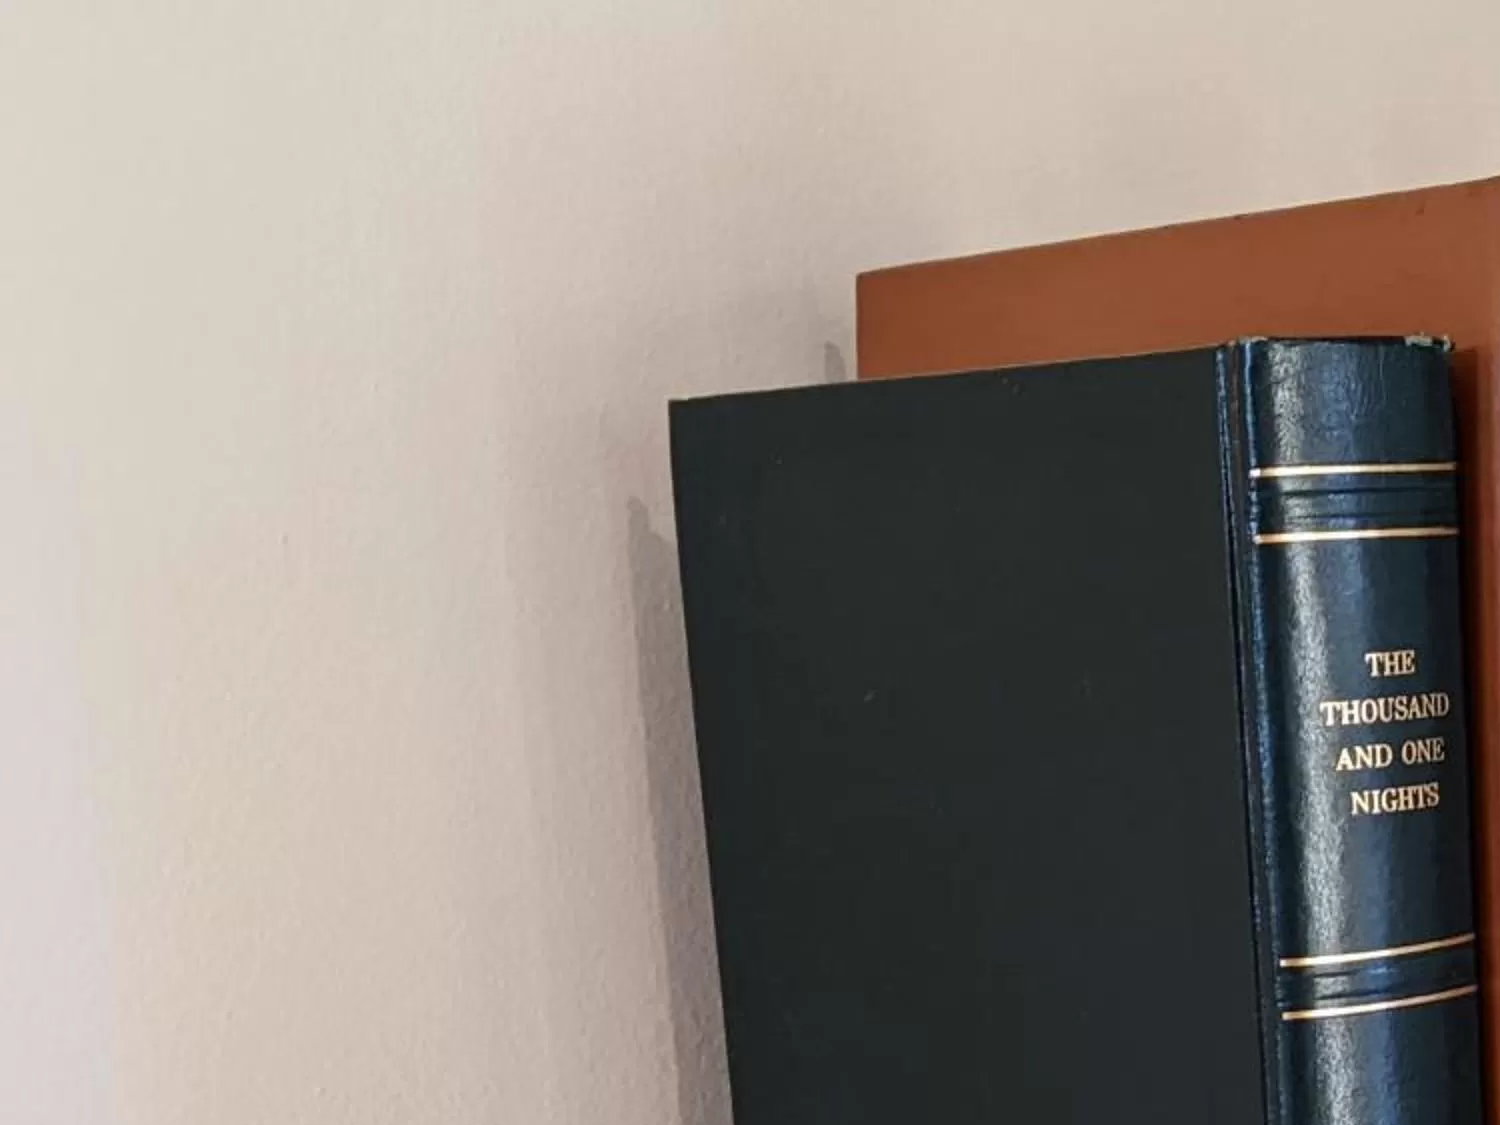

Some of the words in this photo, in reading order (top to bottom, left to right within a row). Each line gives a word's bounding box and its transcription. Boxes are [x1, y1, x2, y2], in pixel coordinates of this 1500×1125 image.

[1364, 650, 1416, 678] THE
[1319, 692, 1450, 727] THOUSAND
[1336, 743, 1394, 771] AND
[1401, 737, 1446, 765] ONE
[1350, 782, 1440, 816] NIGHTS
